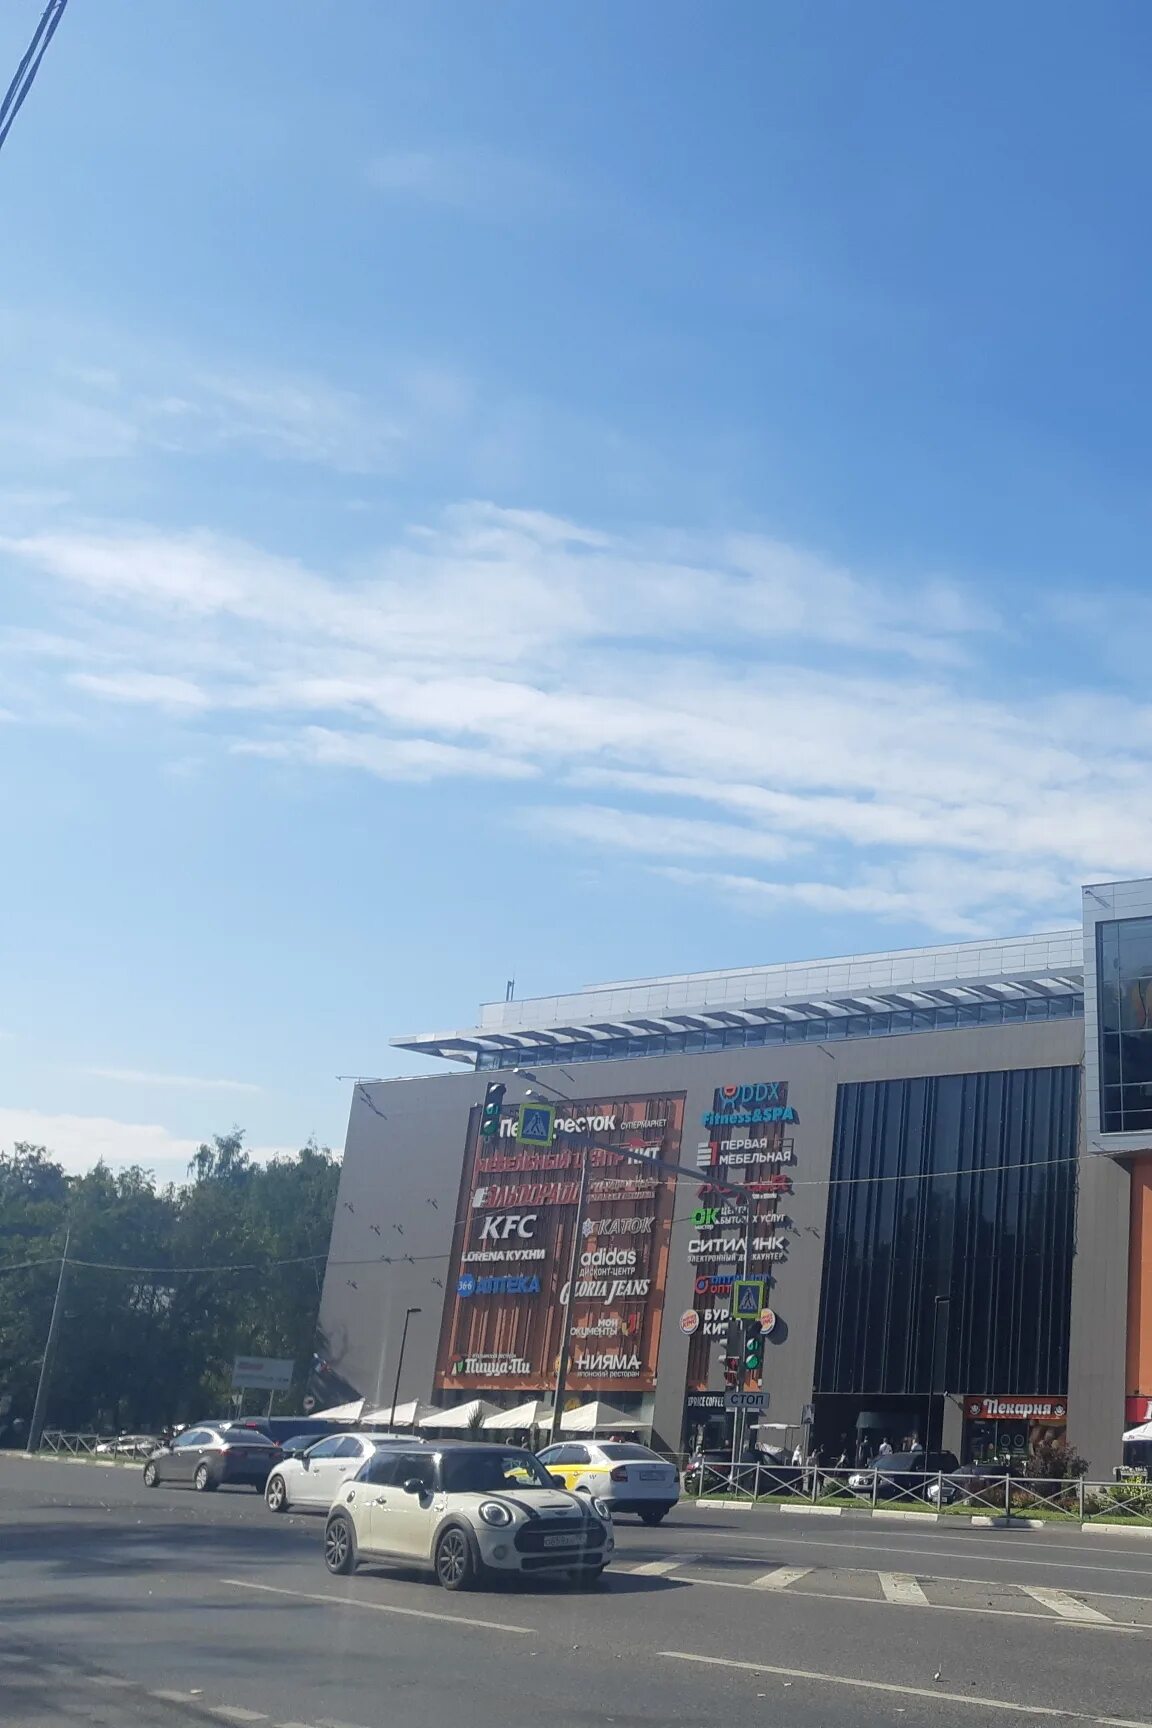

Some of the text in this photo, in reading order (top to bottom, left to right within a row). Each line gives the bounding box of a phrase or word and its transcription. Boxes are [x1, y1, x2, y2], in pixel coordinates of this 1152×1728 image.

[741, 1083, 779, 1102] DDX
[620, 1119, 667, 1130] СУПЕРМАРКЕТ
[721, 1138, 768, 1151] ПЕРВАЯ
[719, 1151, 792, 1165] МЕБЕЛЬНАЯ
[486, 1183, 580, 1208] ЭЛЬДОРАД
[479, 1214, 537, 1239] KFC
[597, 1216, 655, 1235] КАТОК
[461, 1249, 546, 1263] LORENA КУХНИ
[580, 1247, 637, 1266] adidas
[579, 1266, 636, 1277] ДИСКОНТ-ЦЕНТР
[475, 1274, 540, 1295] АПТЕКА
[604, 1279, 651, 1305] JEANS
[570, 1326, 618, 1338] окументы
[575, 1354, 642, 1370] НИЯМА
[609, 1370, 640, 1378] ресторан
[730, 1394, 764, 1405] СТОП
[983, 1399, 1052, 1419] Пекарня
